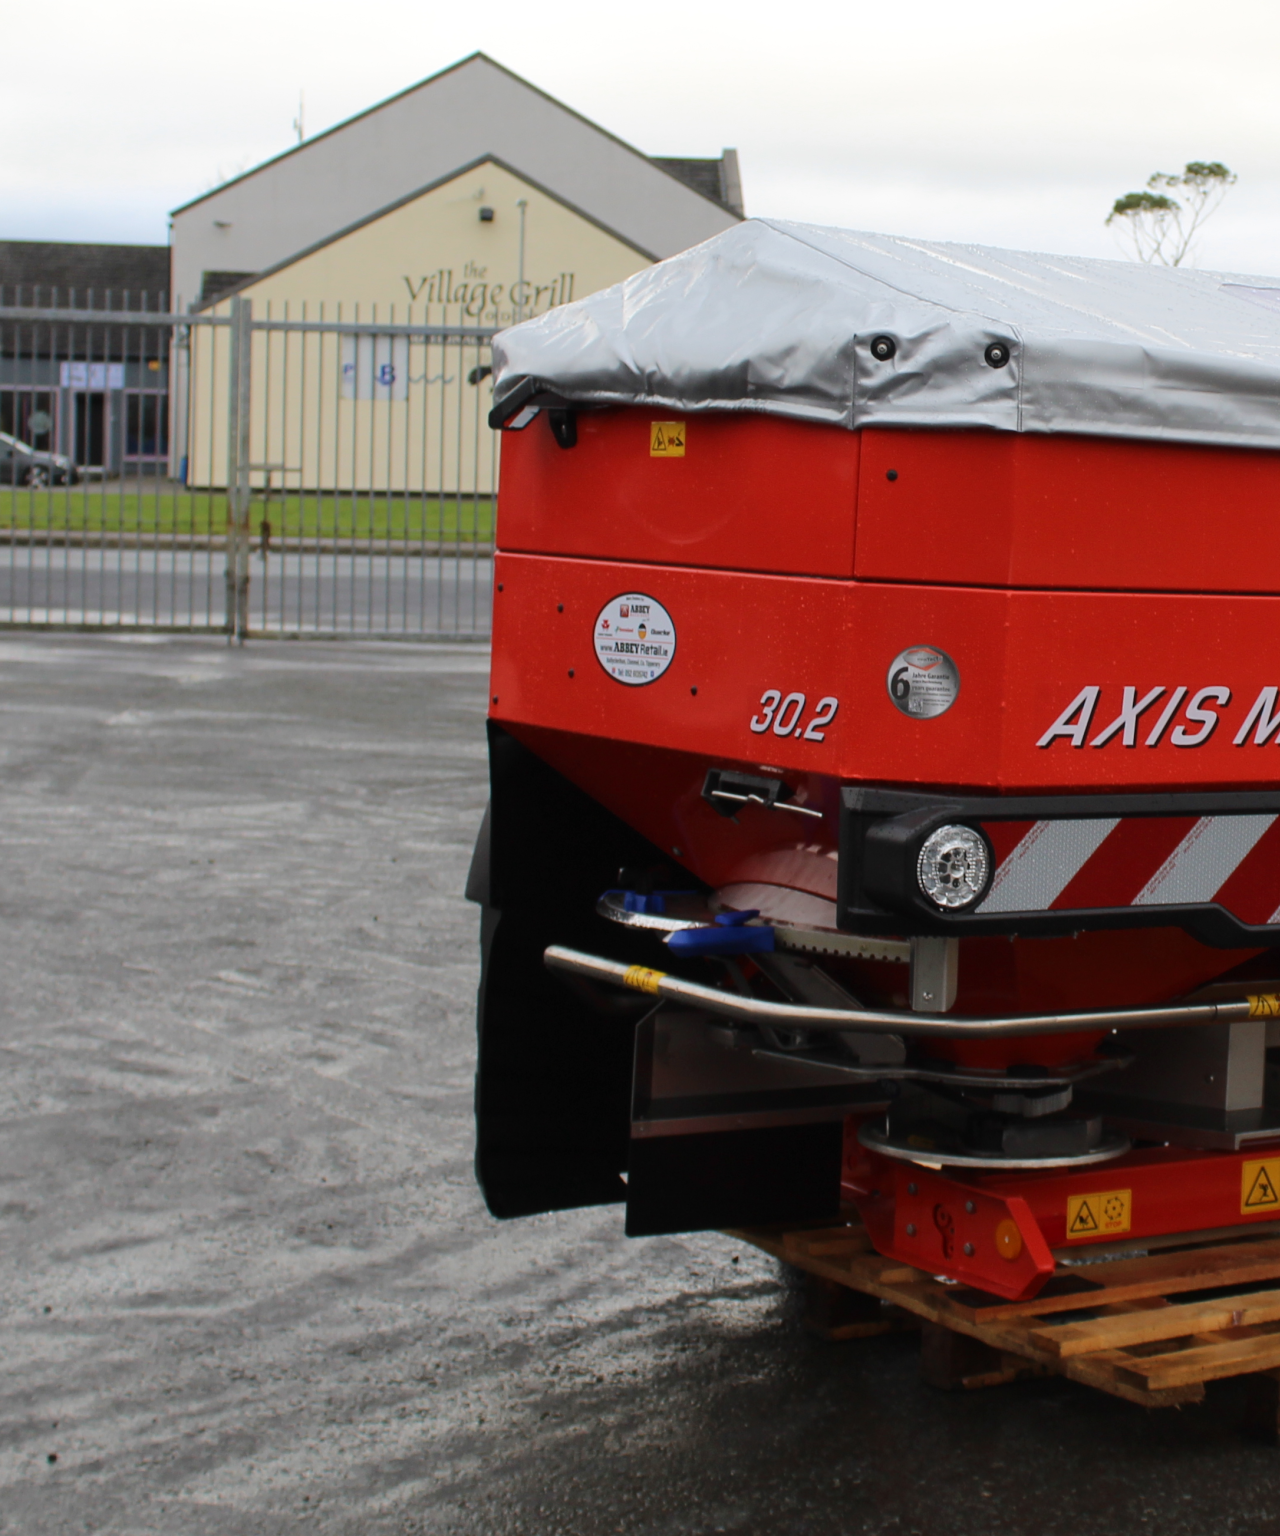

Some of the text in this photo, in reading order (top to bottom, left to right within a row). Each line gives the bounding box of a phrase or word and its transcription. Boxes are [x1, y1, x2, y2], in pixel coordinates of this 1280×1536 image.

[463, 260, 488, 280] the
[402, 269, 575, 318] Village Grill
[630, 604, 651, 614] ABBEY
[891, 666, 911, 700] 6
[750, 689, 839, 741] 30.2
[1035, 685, 1232, 748] AXIS
